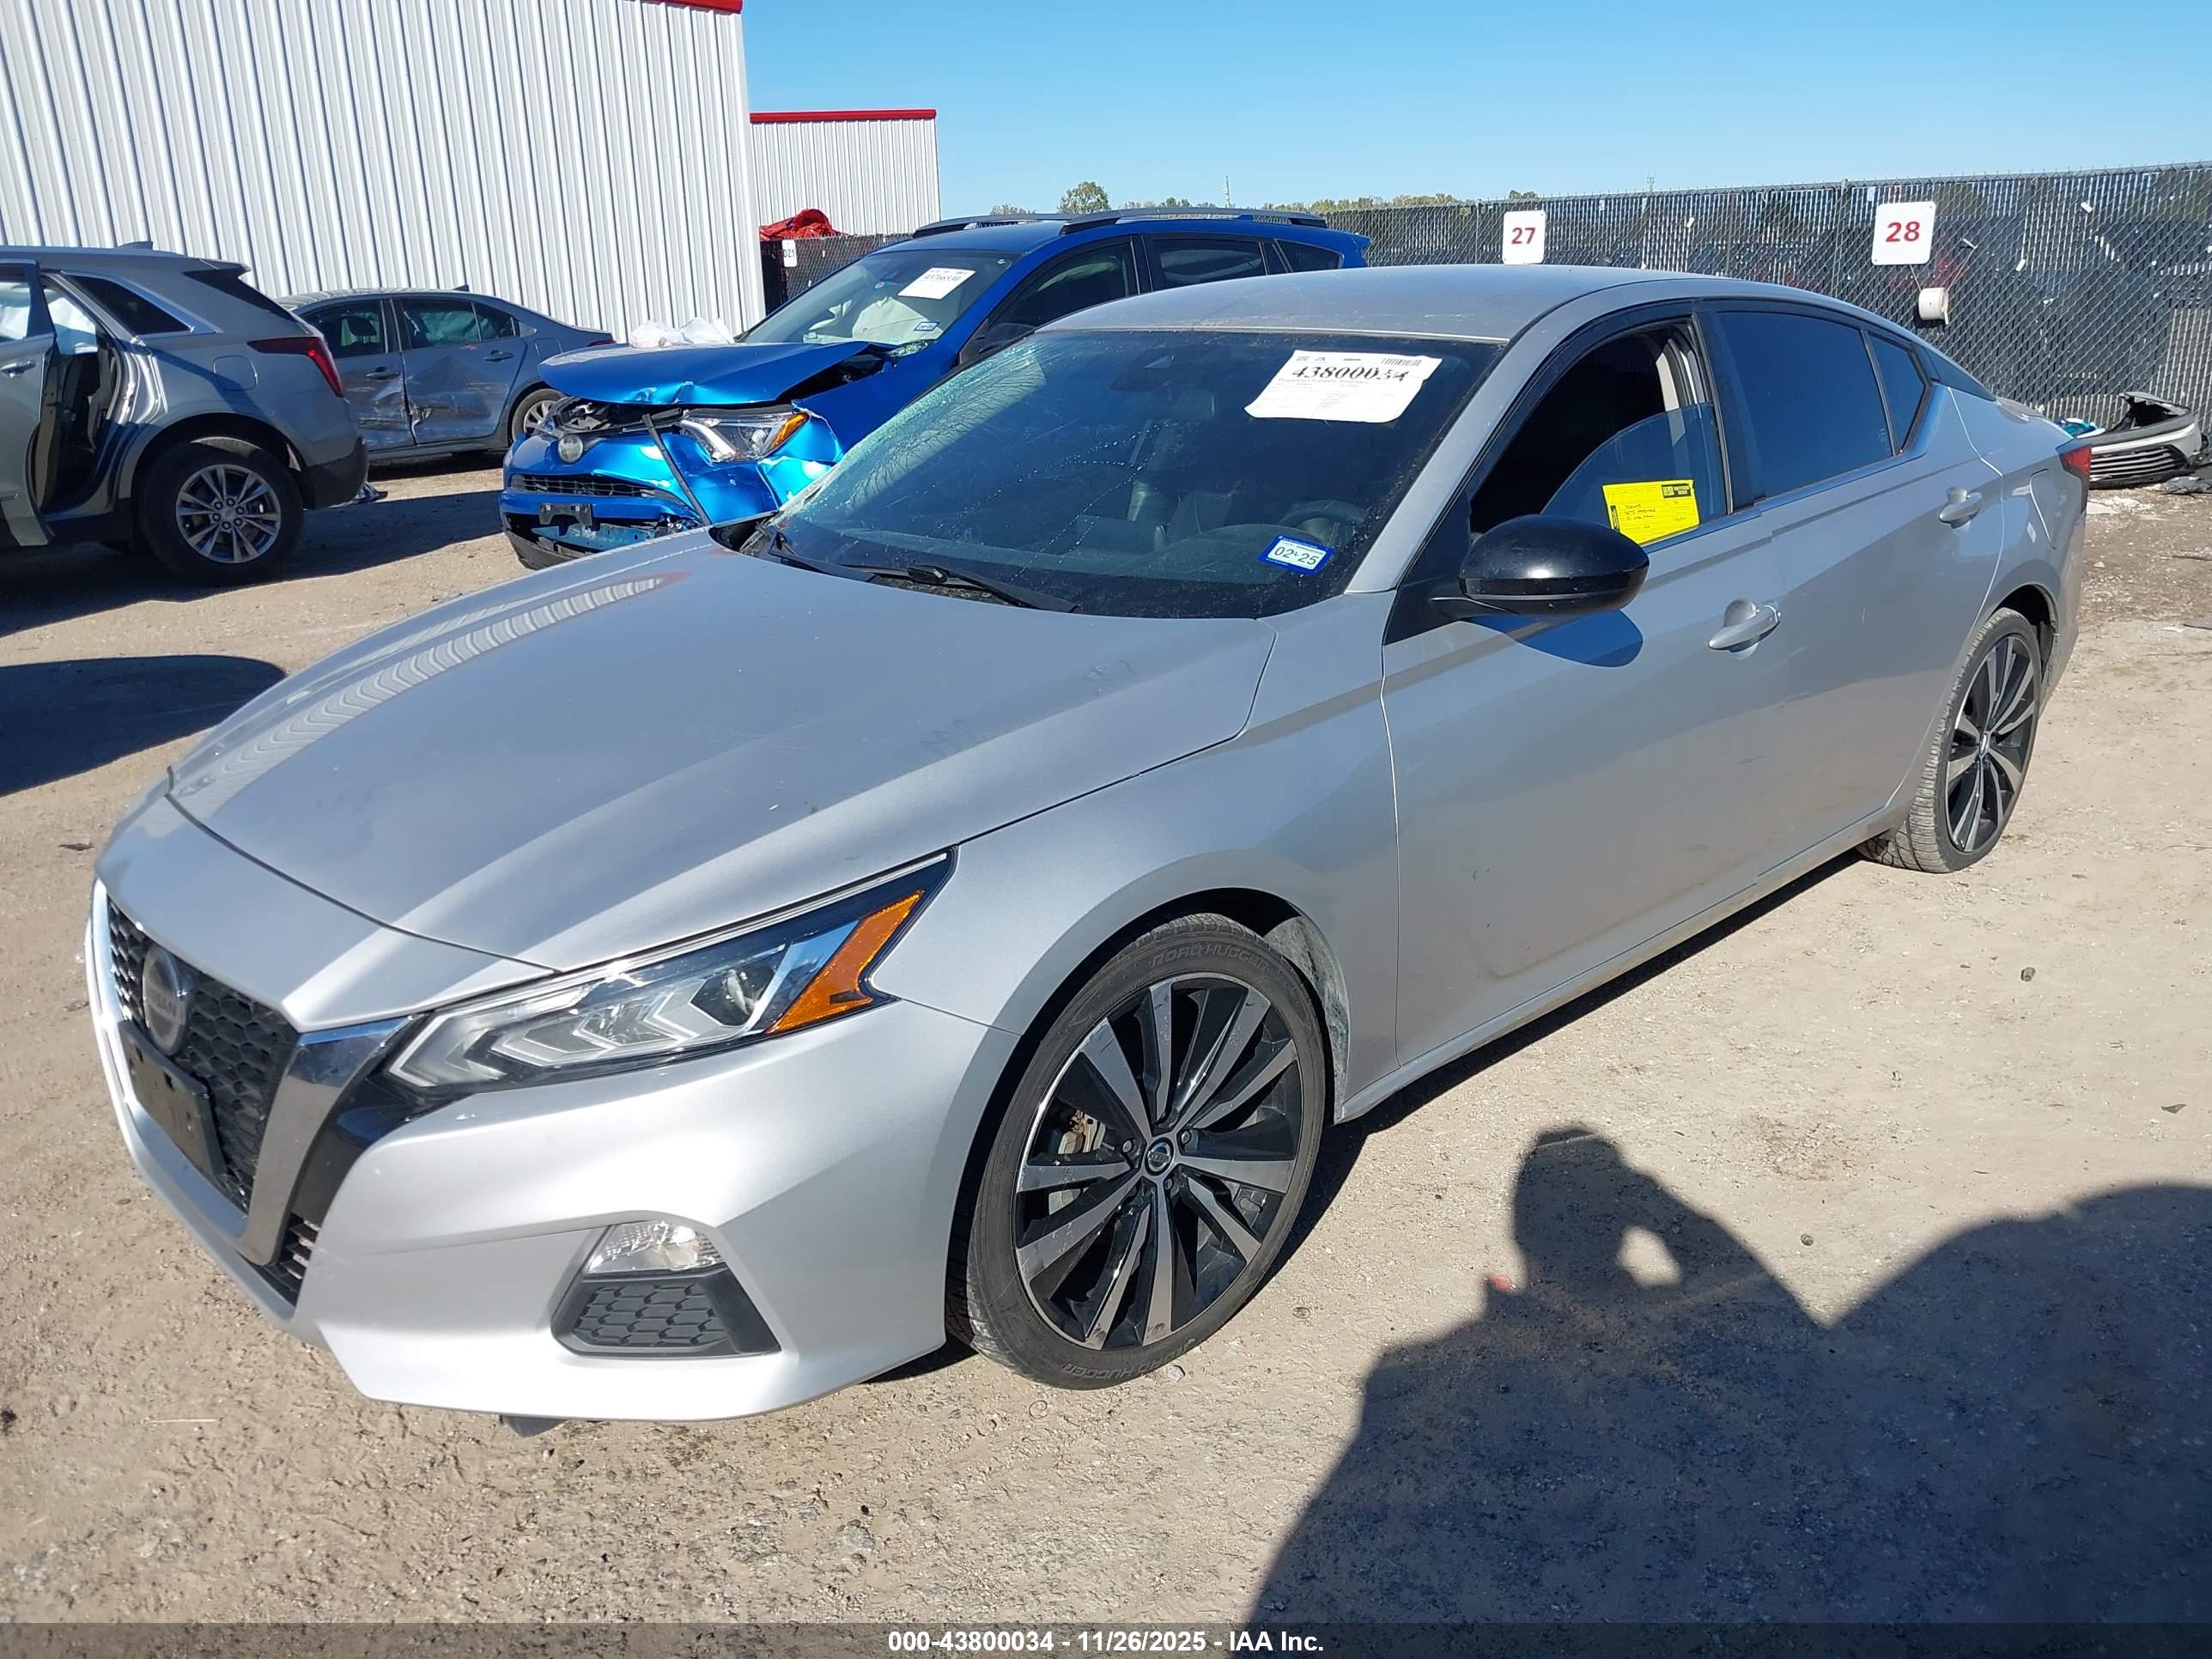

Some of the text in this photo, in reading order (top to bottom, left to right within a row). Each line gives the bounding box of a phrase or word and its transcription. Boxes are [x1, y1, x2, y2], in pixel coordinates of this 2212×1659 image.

[1510, 226, 1536, 245] 27
[1885, 221, 1920, 243] 28
[1275, 547, 1294, 558] 02
[1298, 553, 1319, 565] 25
